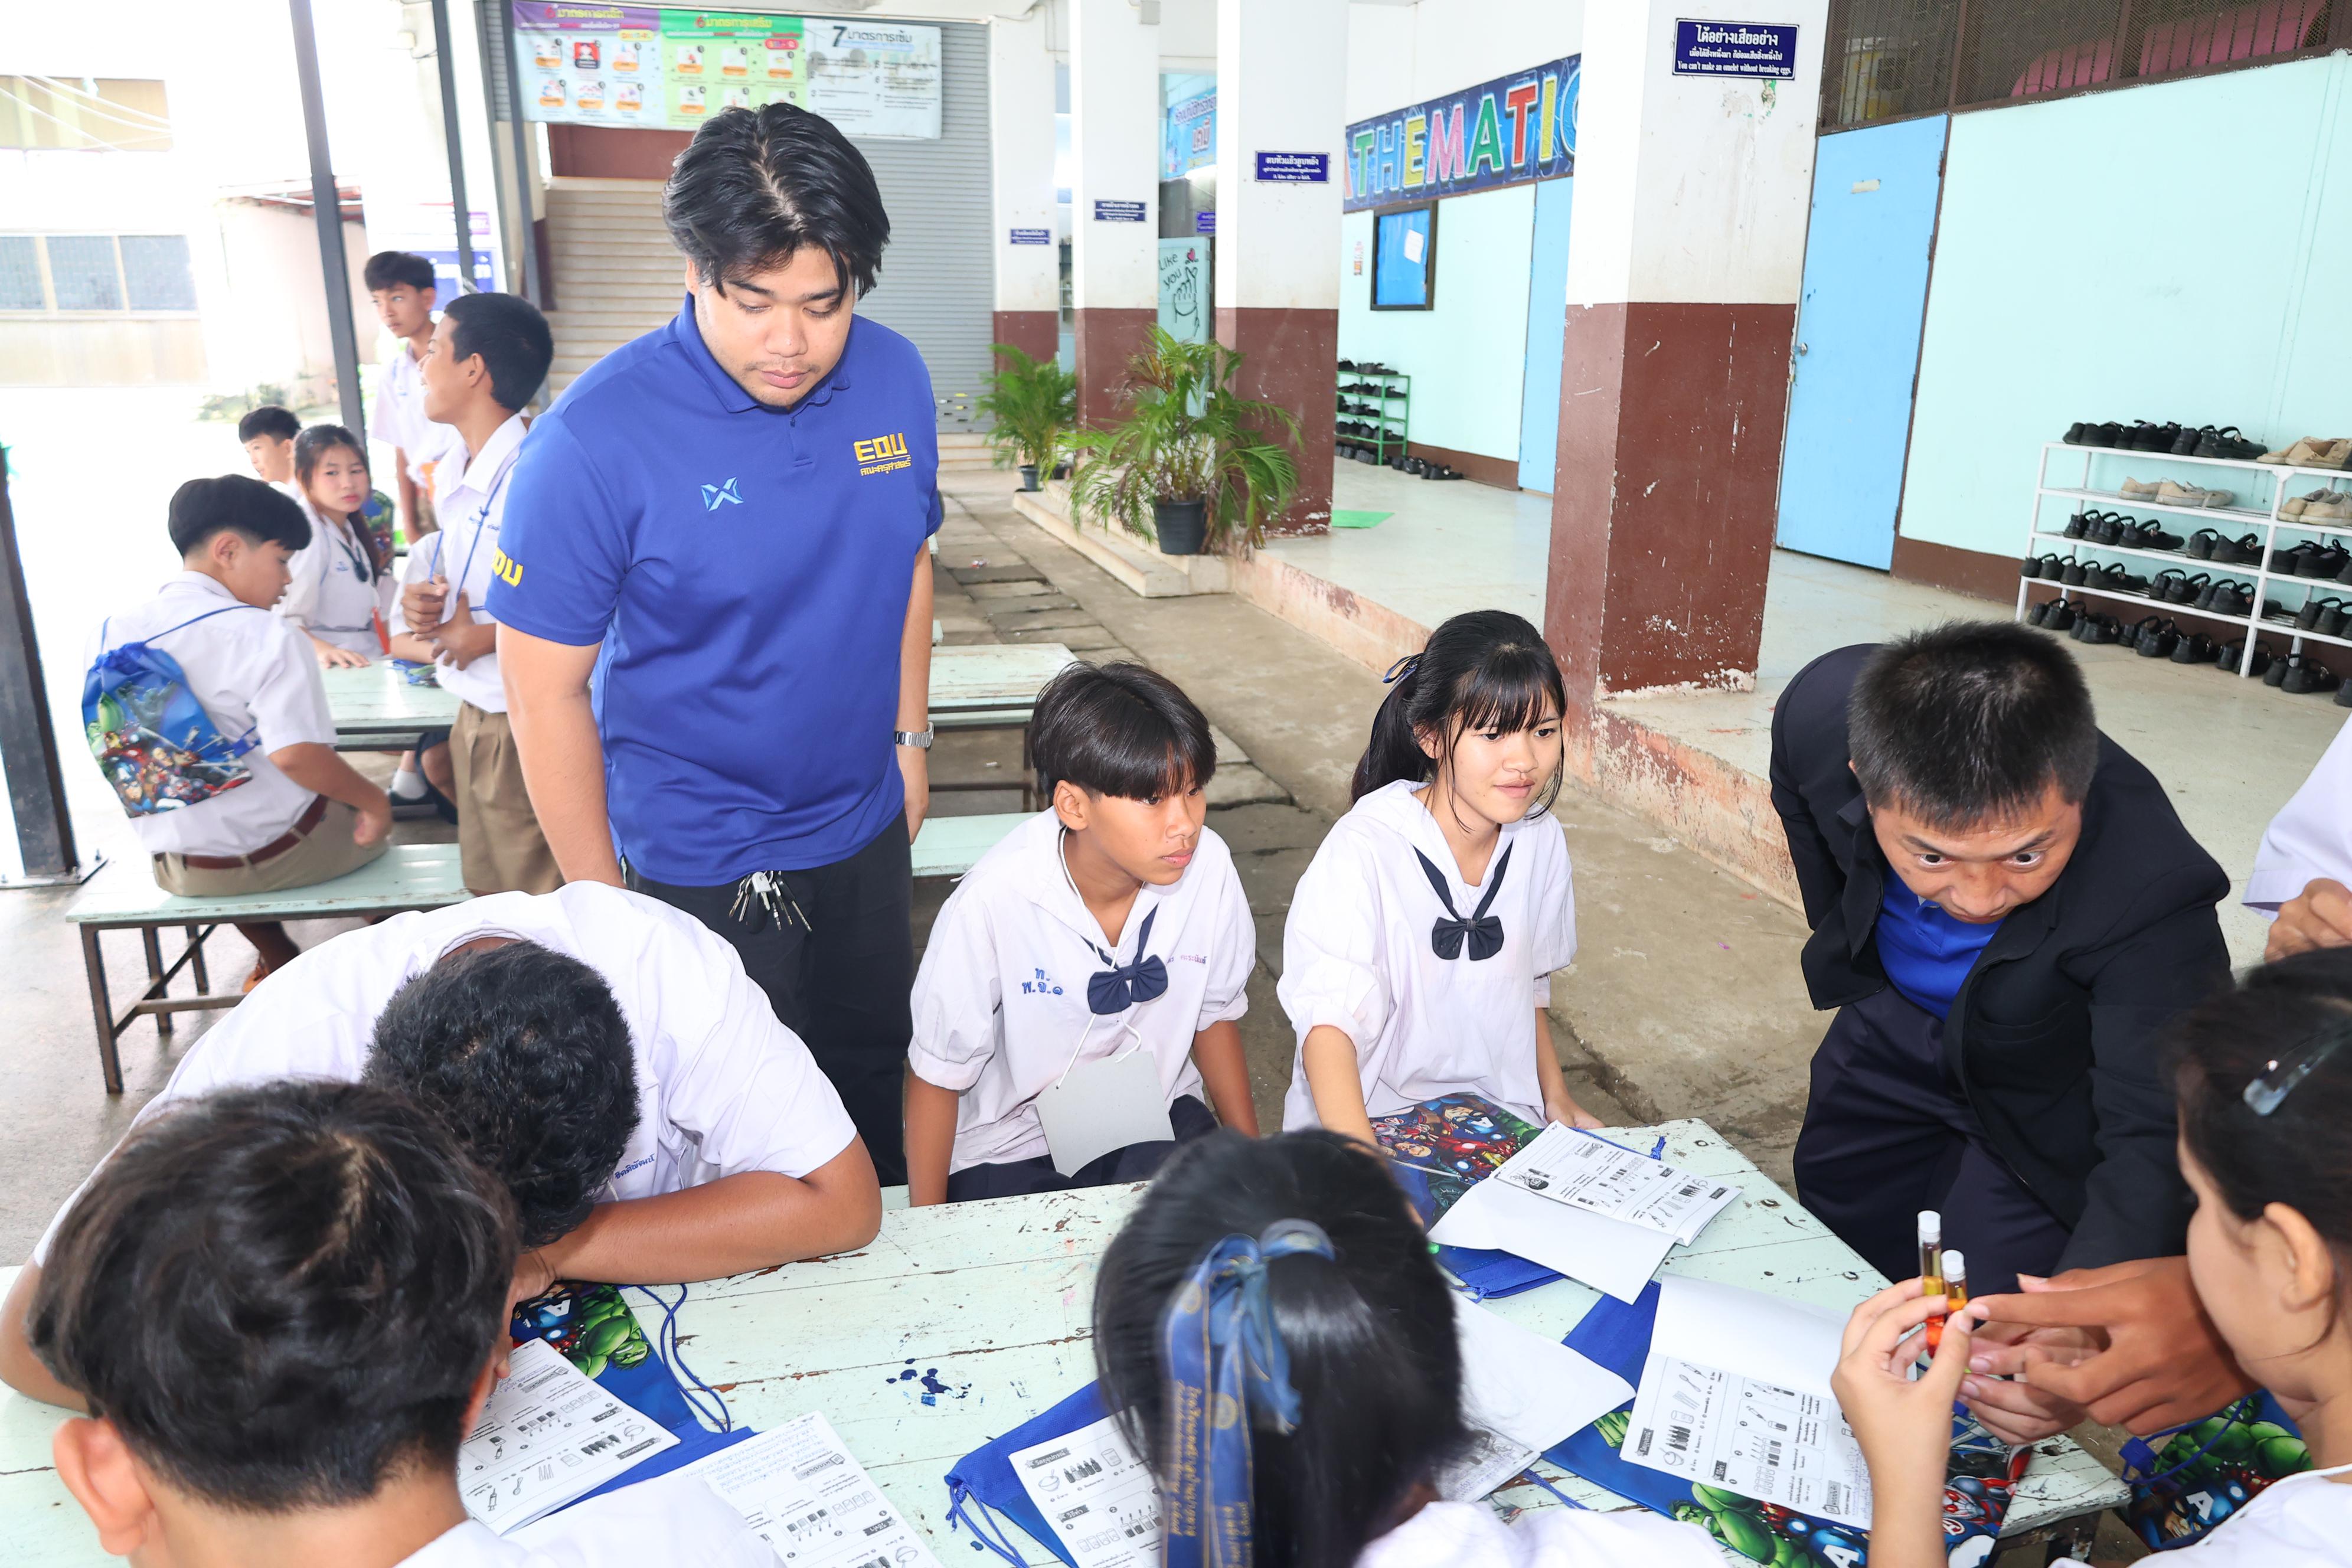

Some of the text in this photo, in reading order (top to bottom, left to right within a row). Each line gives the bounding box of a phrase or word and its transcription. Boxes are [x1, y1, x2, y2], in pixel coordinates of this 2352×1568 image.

[695, 15, 705, 28] 6
[832, 25, 847, 47] 7
[848, 30, 913, 43] มาตรการเข้ม
[1696, 24, 1778, 46] ได้อย่างเสียอย่าง
[854, 433, 908, 462] EDU
[860, 456, 912, 476] คณะครุศาสตร์
[491, 547, 524, 587] DU
[1065, 1508, 1084, 1518] วิธีทำ
